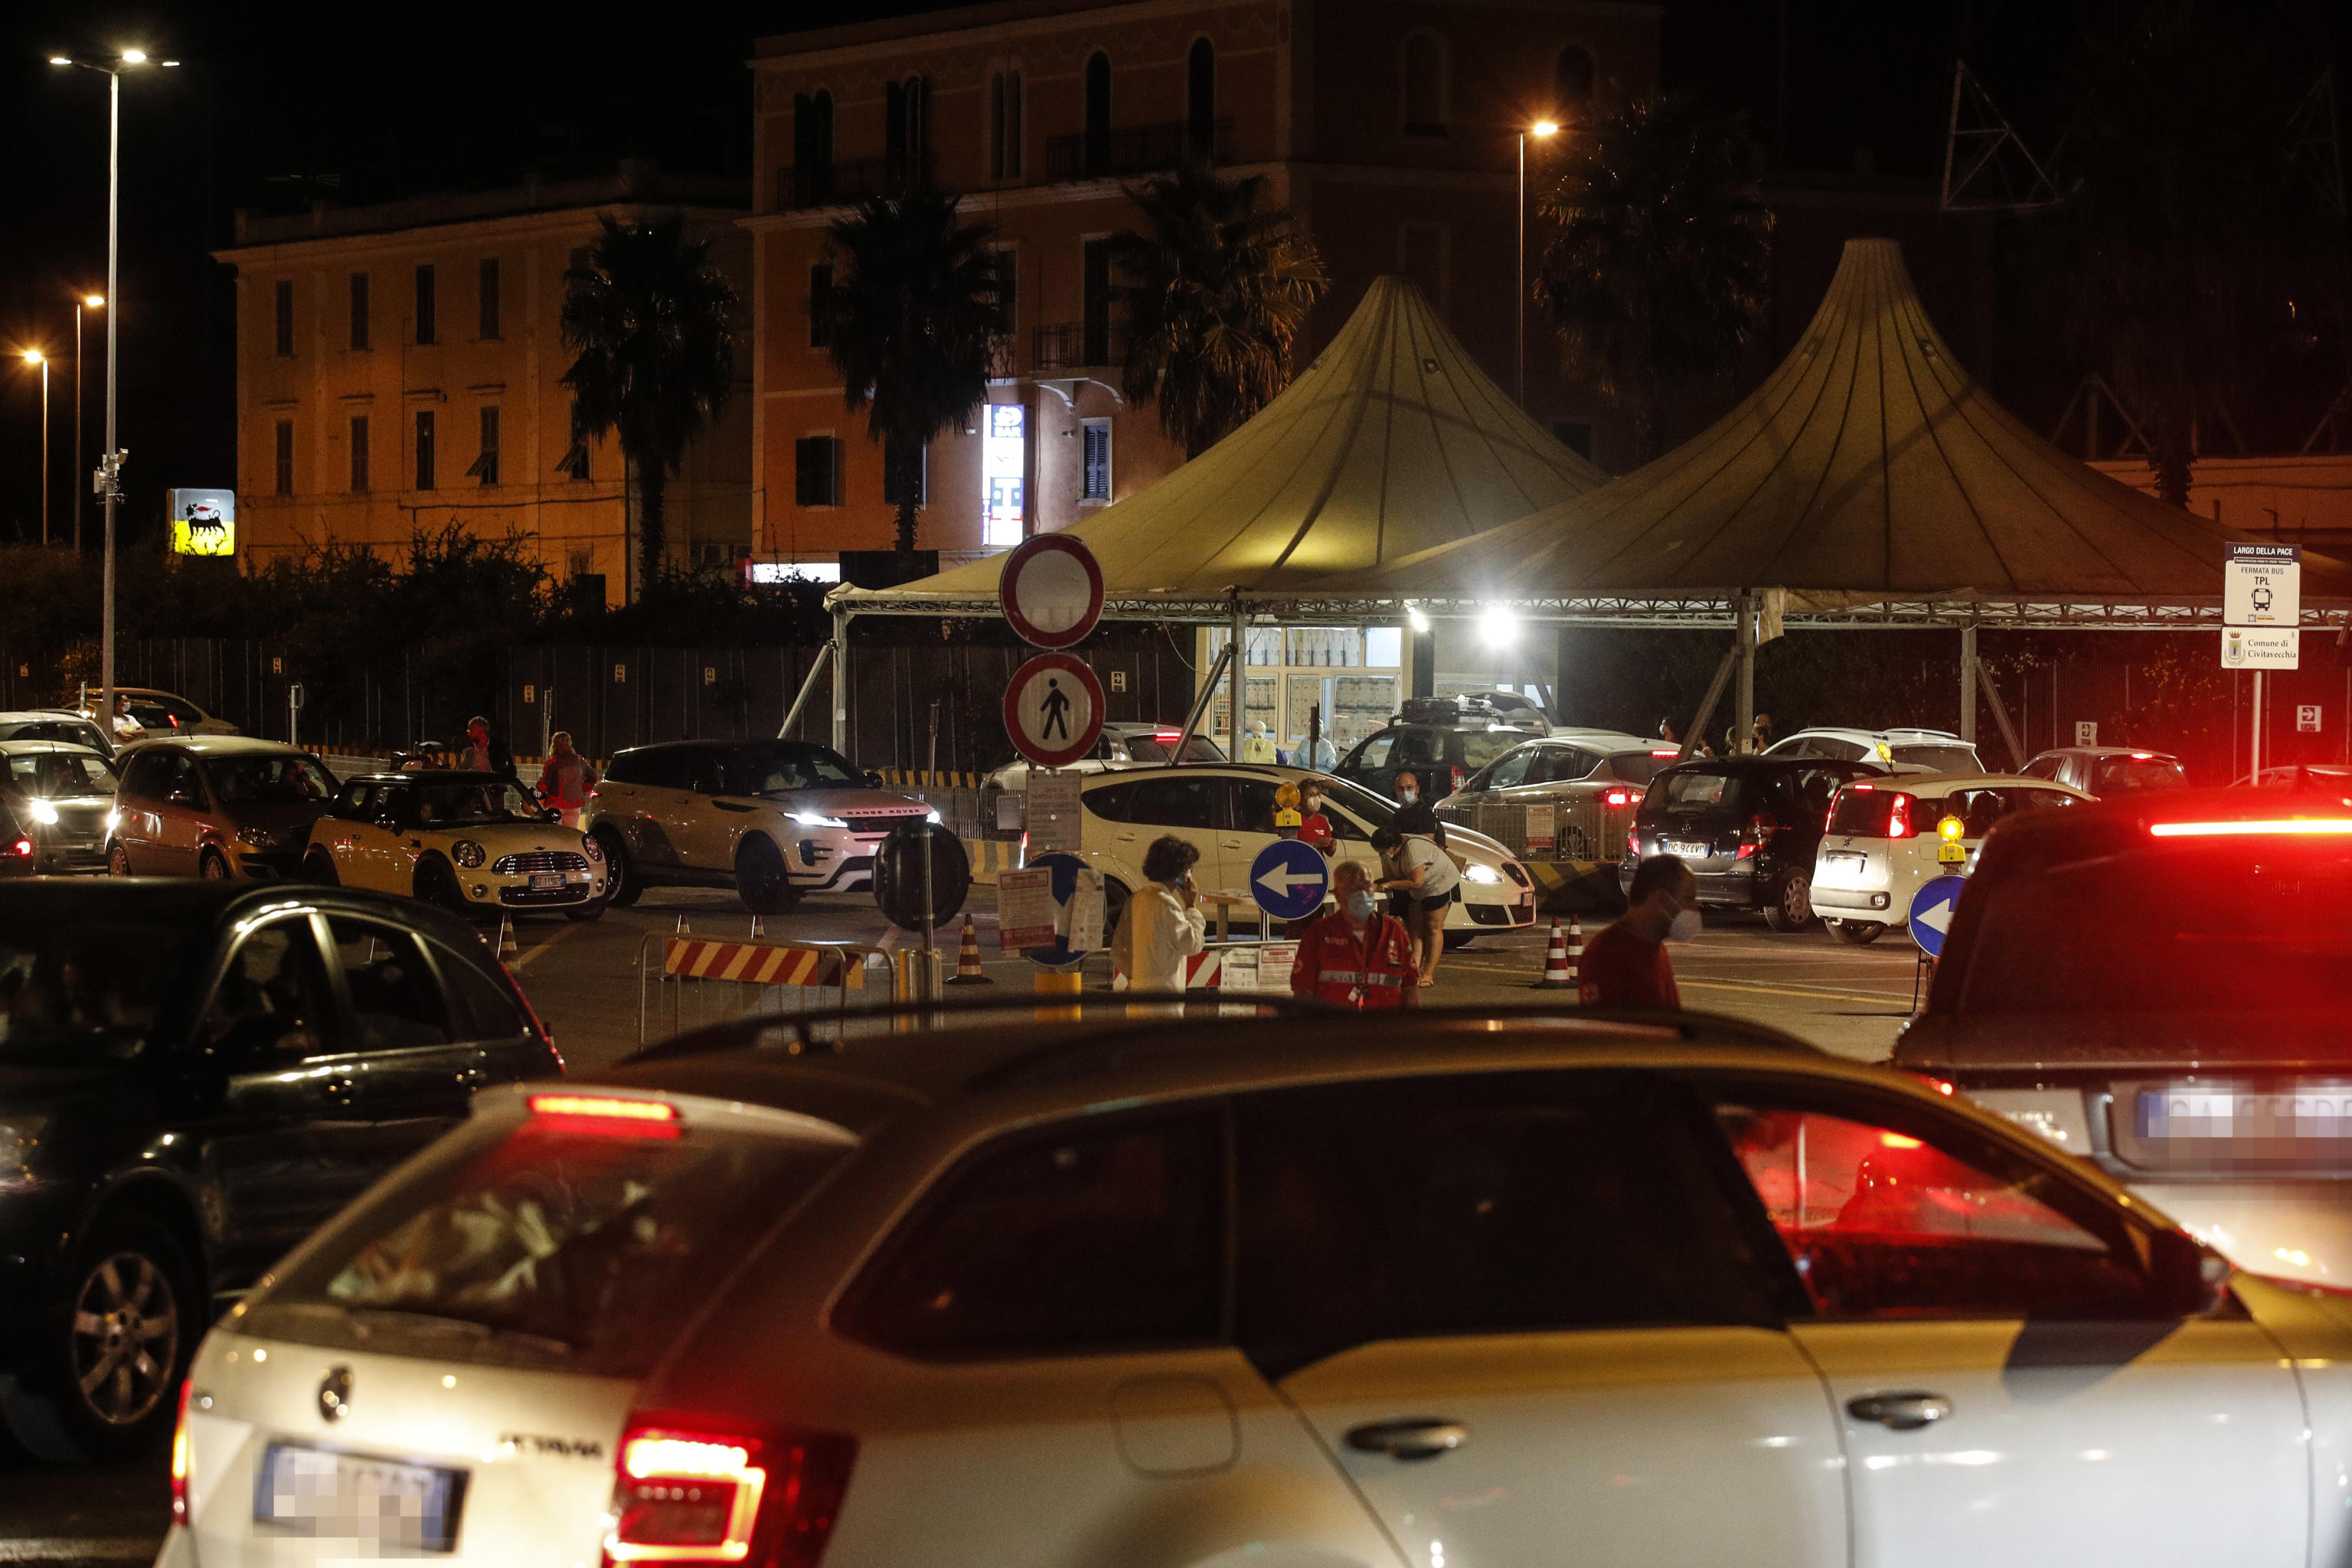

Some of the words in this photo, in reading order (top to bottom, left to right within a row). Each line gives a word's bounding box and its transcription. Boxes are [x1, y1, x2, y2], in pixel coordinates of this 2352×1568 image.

[2255, 577, 2270, 585] TPL
[2248, 639, 2279, 647] Comune
[2248, 650, 2296, 658] Civitavecchia
